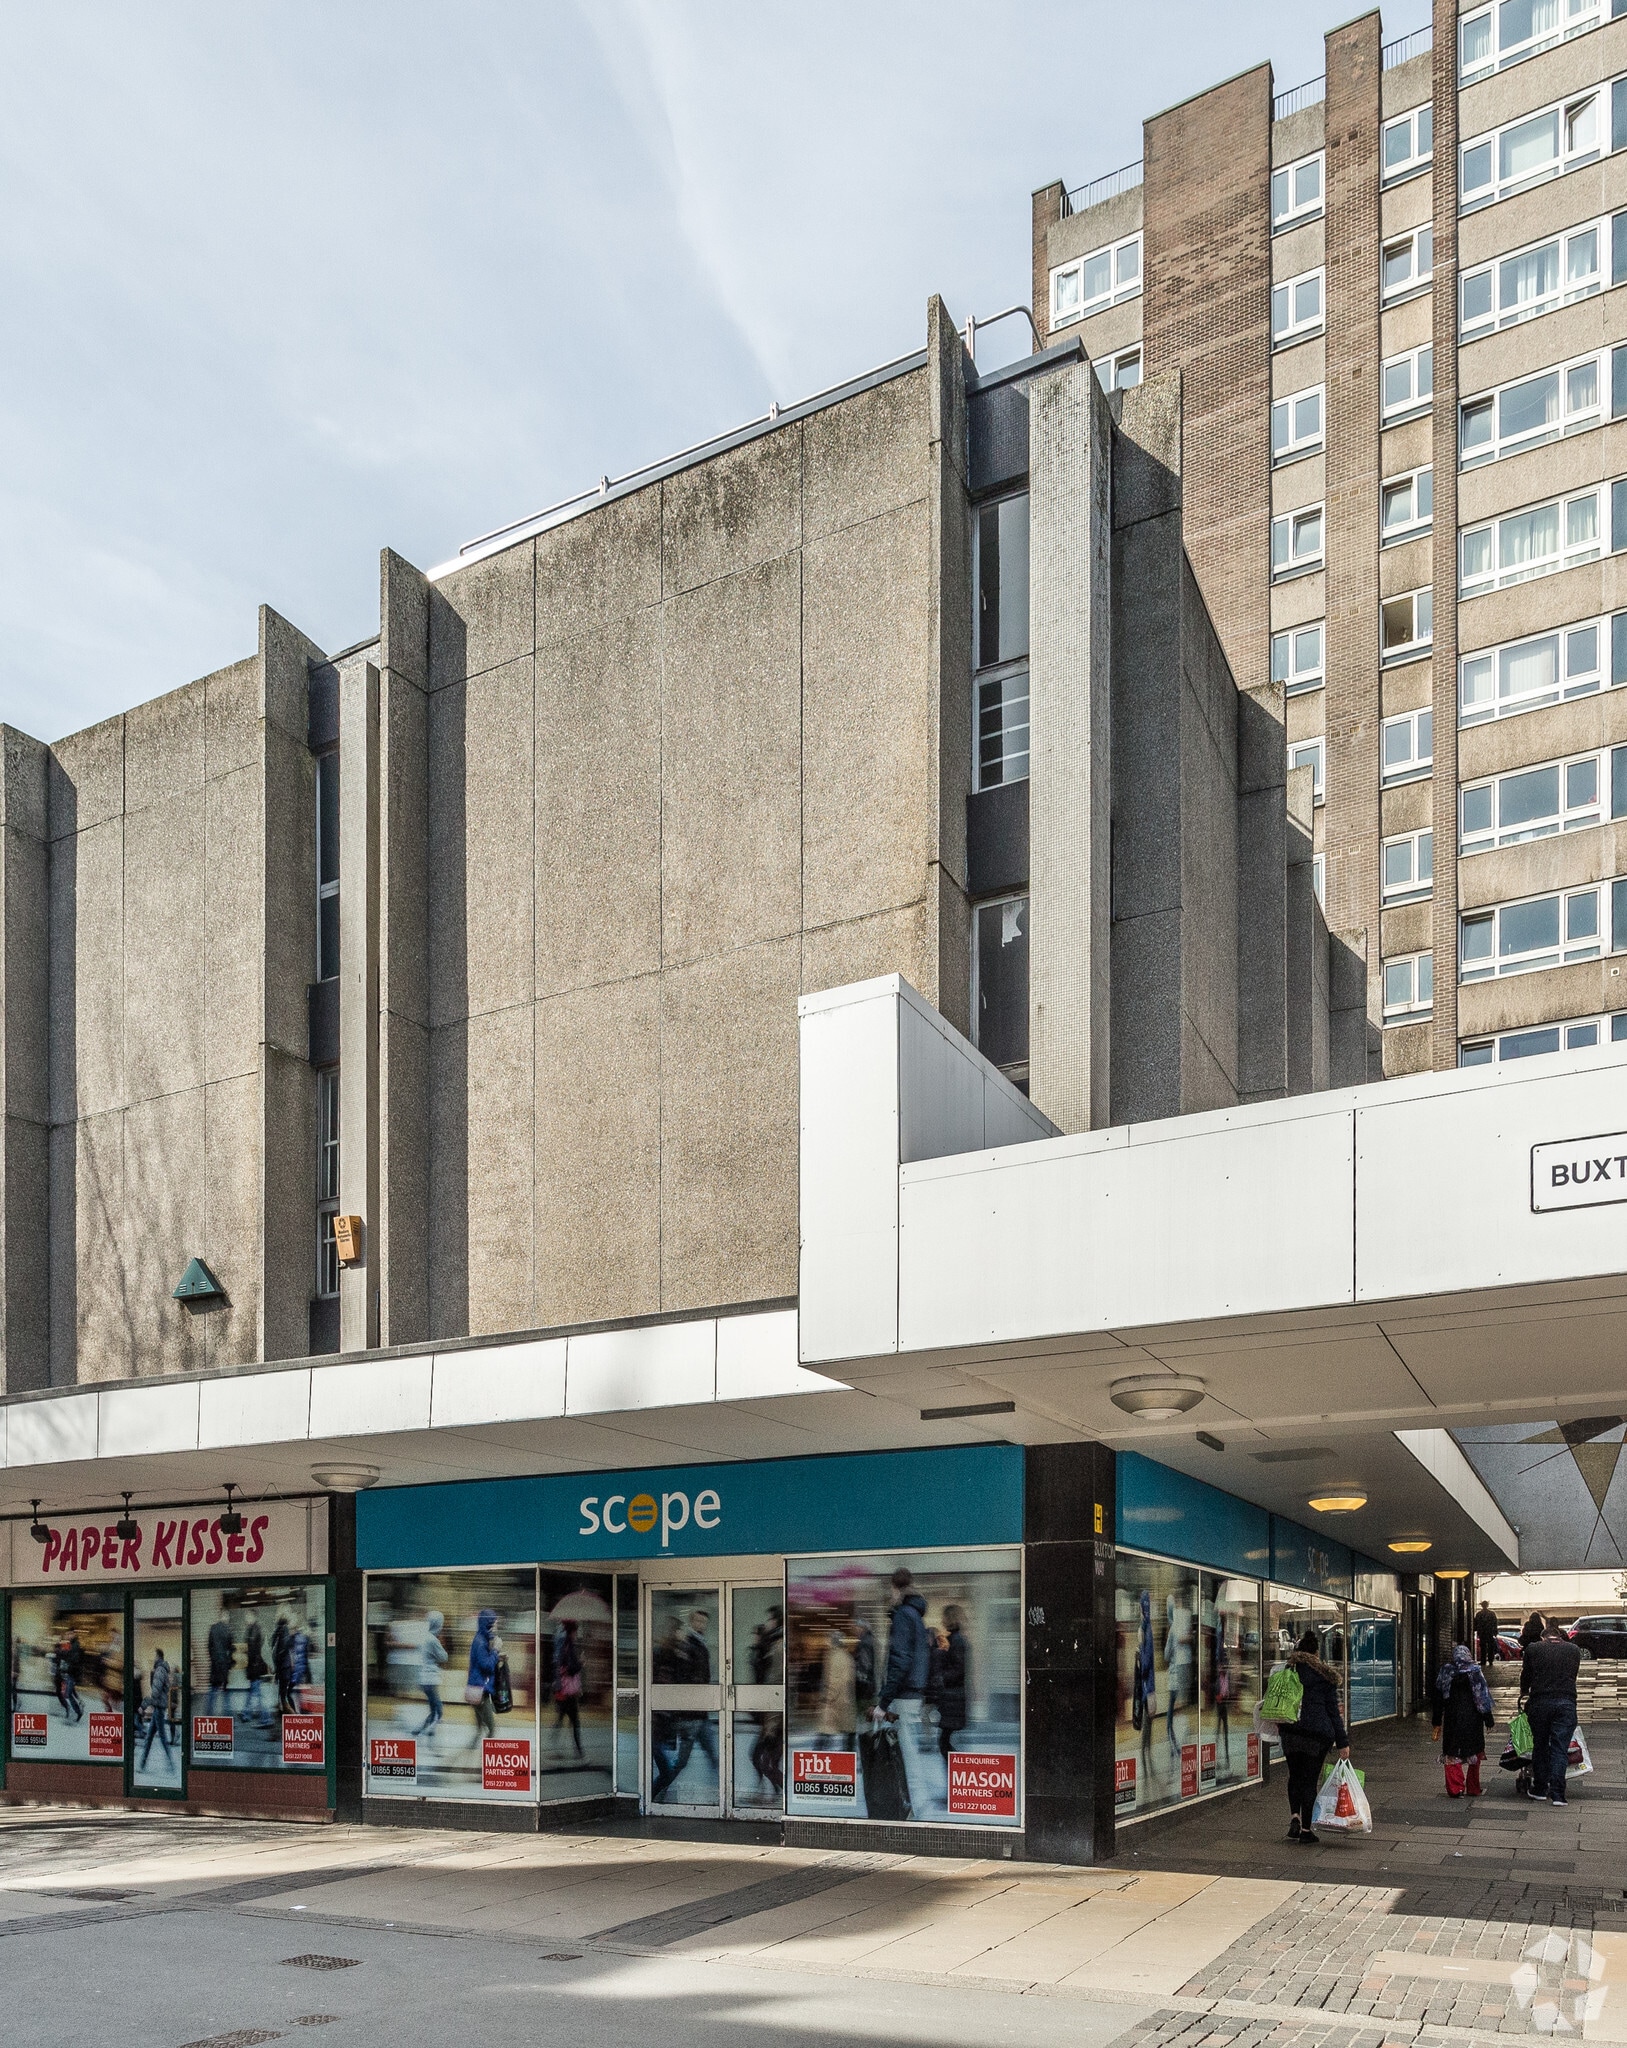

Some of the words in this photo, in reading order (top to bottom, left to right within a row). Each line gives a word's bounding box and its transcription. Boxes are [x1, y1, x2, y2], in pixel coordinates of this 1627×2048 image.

[579, 1490, 721, 1548] scope
[42, 1525, 142, 1573] PAPER
[152, 1516, 269, 1570] KISSES
[17, 1715, 35, 1732] jrbt
[91, 1726, 122, 1737] MASON
[197, 1719, 218, 1736] jrbt
[285, 1729, 322, 1741] MASON
[374, 1741, 398, 1761] jrbt
[485, 1754, 528, 1768] MASON
[798, 1753, 831, 1776] jrbt
[372, 1766, 390, 1774] 01865
[392, 1766, 414, 1775] 595143
[1116, 1762, 1128, 1787] jrbt
[952, 1771, 1013, 1788] MASON
[795, 1783, 820, 1793] 01865
[823, 1784, 854, 1794] 595143
